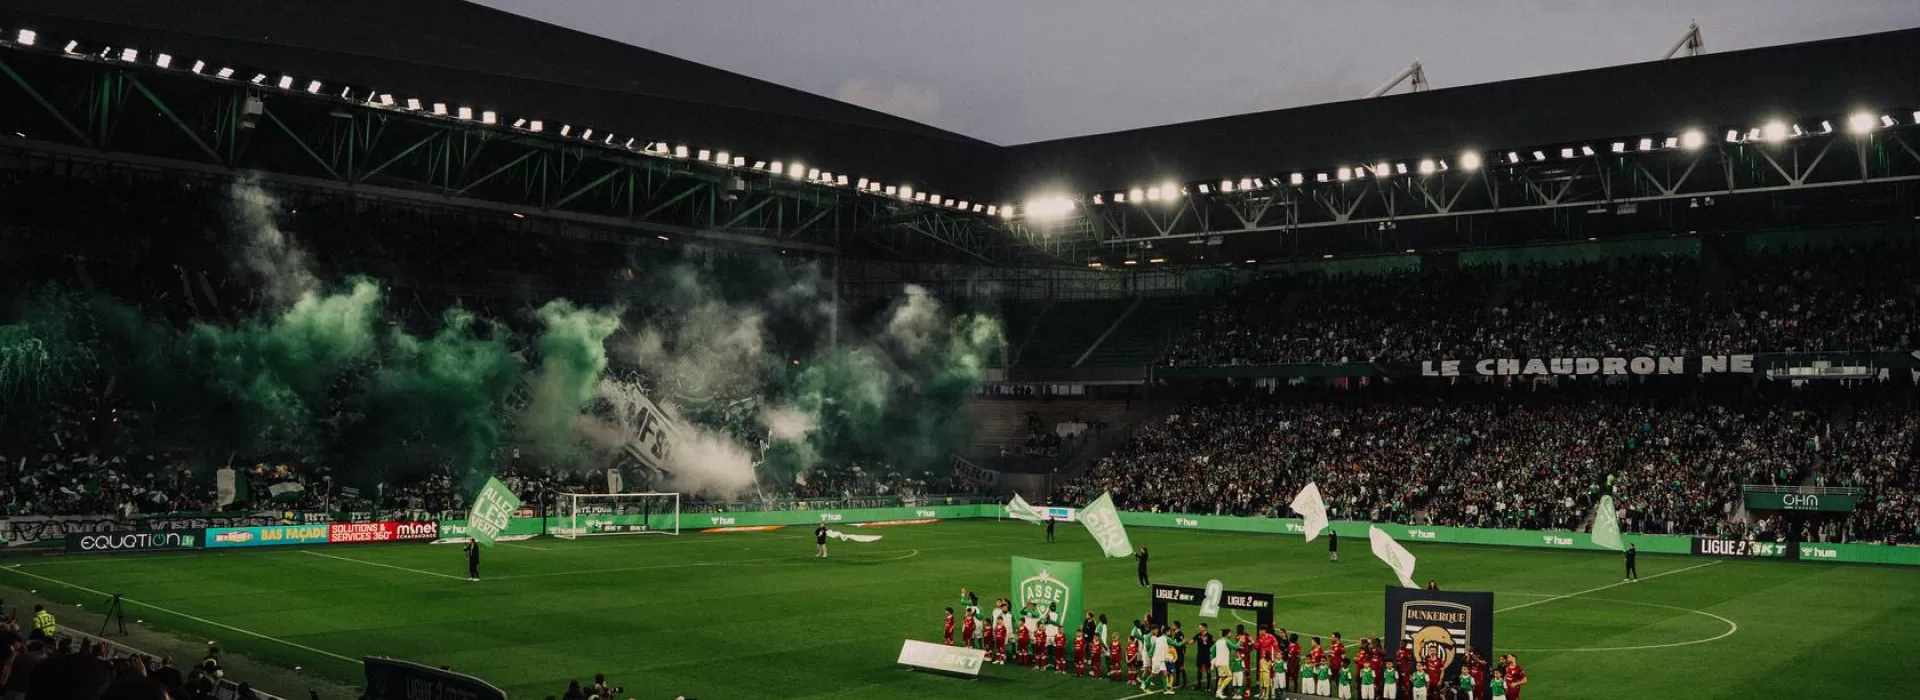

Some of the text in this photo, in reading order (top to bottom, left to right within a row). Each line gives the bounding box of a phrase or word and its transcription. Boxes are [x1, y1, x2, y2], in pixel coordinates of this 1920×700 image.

[1422, 354, 1754, 376] LE CHAUDRON NE
[1783, 494, 1818, 506] OHM
[472, 497, 508, 530] LES
[261, 528, 282, 540] BAS
[286, 527, 327, 542] FAÇADE
[332, 523, 378, 533] SOLUTIONS
[332, 532, 371, 542] SERVICES
[1701, 539, 1737, 555] LIGUE
[1735, 540, 1745, 556] 2
[1814, 547, 1837, 557] hum
[1027, 584, 1062, 602] ASSE
[1156, 589, 1174, 600] LIGUE
[1199, 579, 1223, 618] 2
[1227, 595, 1246, 606] LIGUE
[1407, 609, 1465, 623] DUNKERQUE
